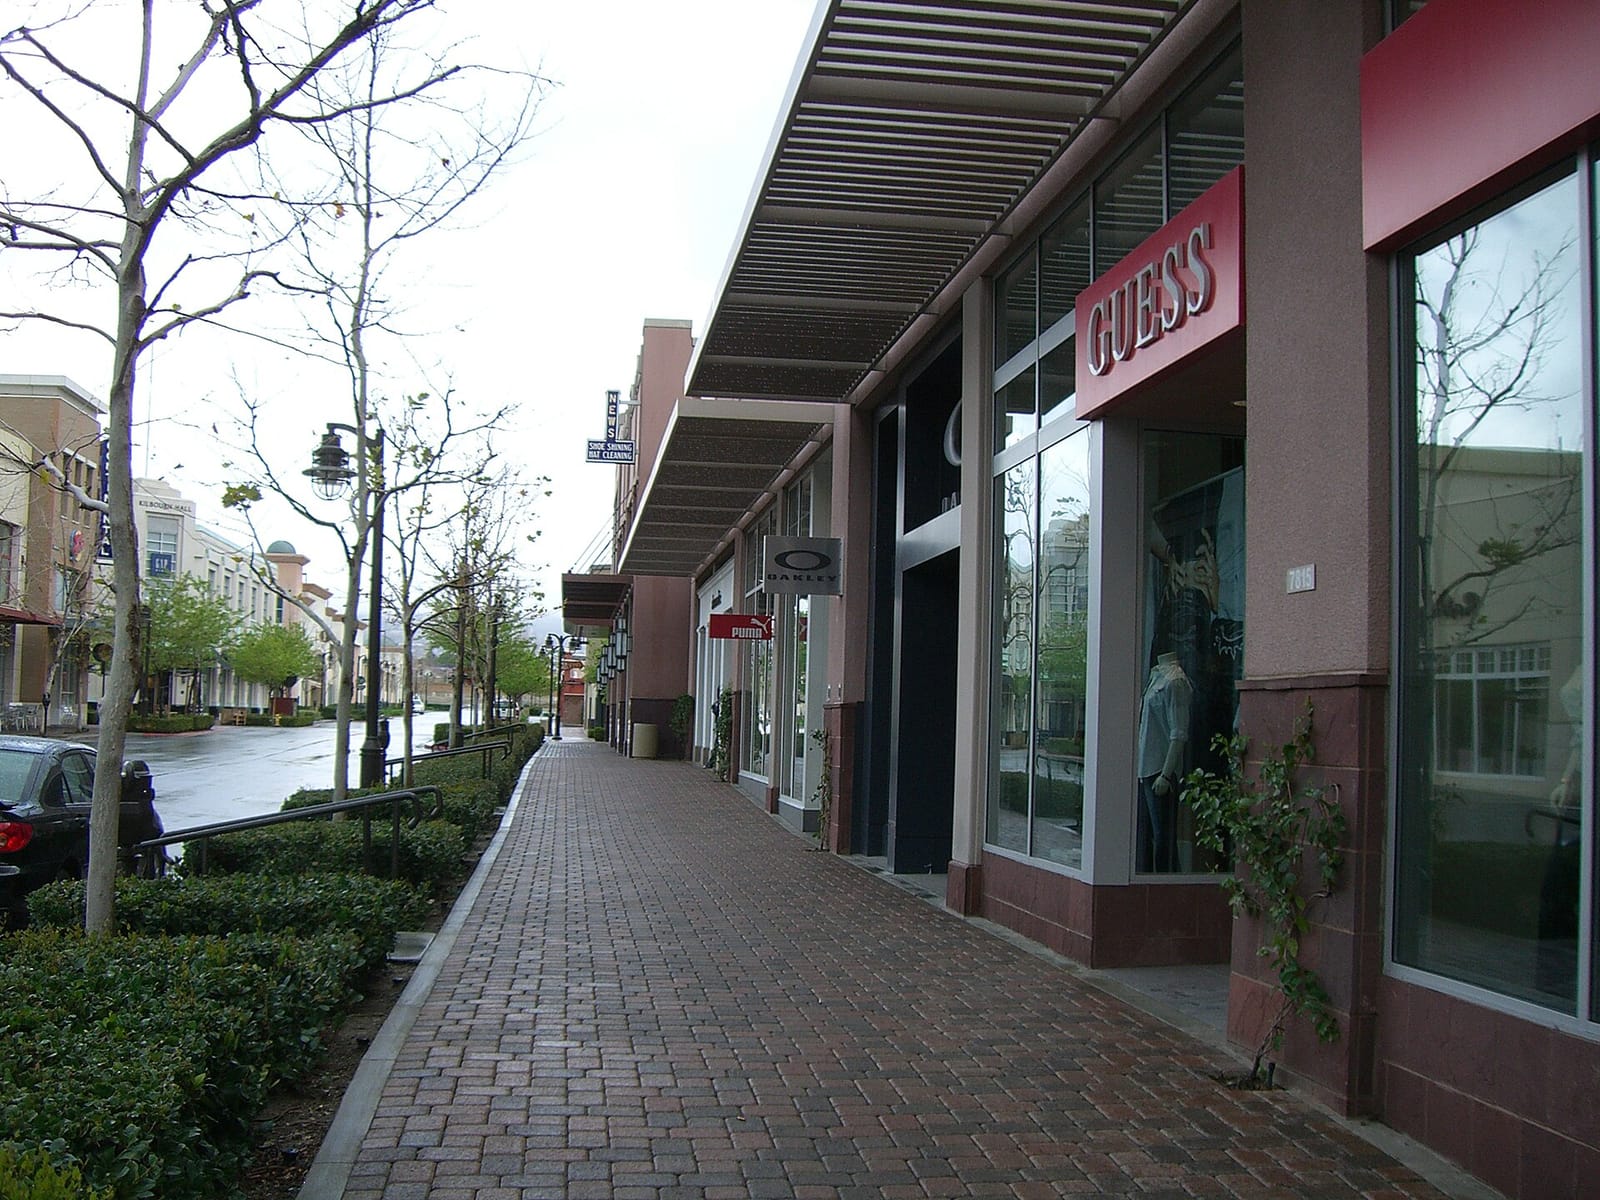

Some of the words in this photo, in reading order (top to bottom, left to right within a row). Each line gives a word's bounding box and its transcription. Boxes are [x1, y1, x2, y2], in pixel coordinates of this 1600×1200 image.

[1087, 222, 1215, 377] GUESS
[607, 393, 617, 438] NEWS
[589, 442, 606, 450] SHOE
[607, 443, 632, 451] SHINING
[589, 450, 600, 458] HAT
[602, 451, 632, 460] CLEANING
[767, 574, 837, 582] OAKLEY
[731, 627, 762, 638] PUMA
